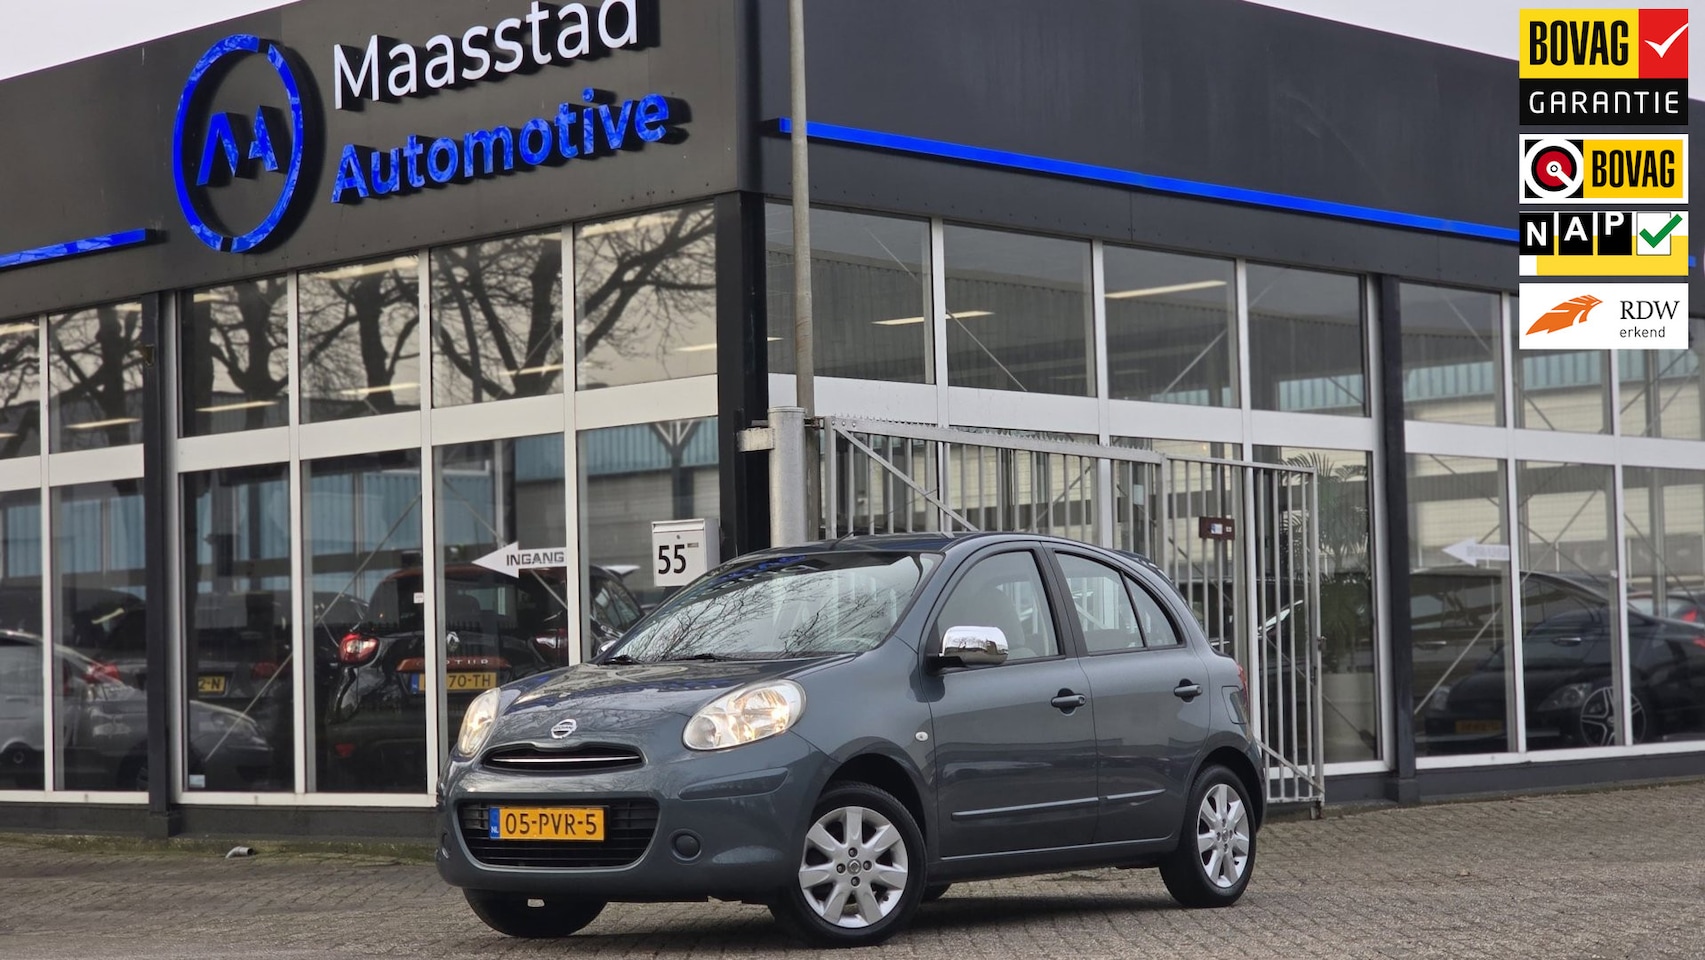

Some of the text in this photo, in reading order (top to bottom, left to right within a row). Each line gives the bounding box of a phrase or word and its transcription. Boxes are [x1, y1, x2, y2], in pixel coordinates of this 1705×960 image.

[333, 0, 639, 110] Maasstad
[331, 87, 670, 204] Automotive
[506, 551, 565, 566] INGANG
[658, 544, 687, 575] 55
[448, 674, 491, 688] 70-TH
[505, 813, 597, 835] 05-PVR-5
